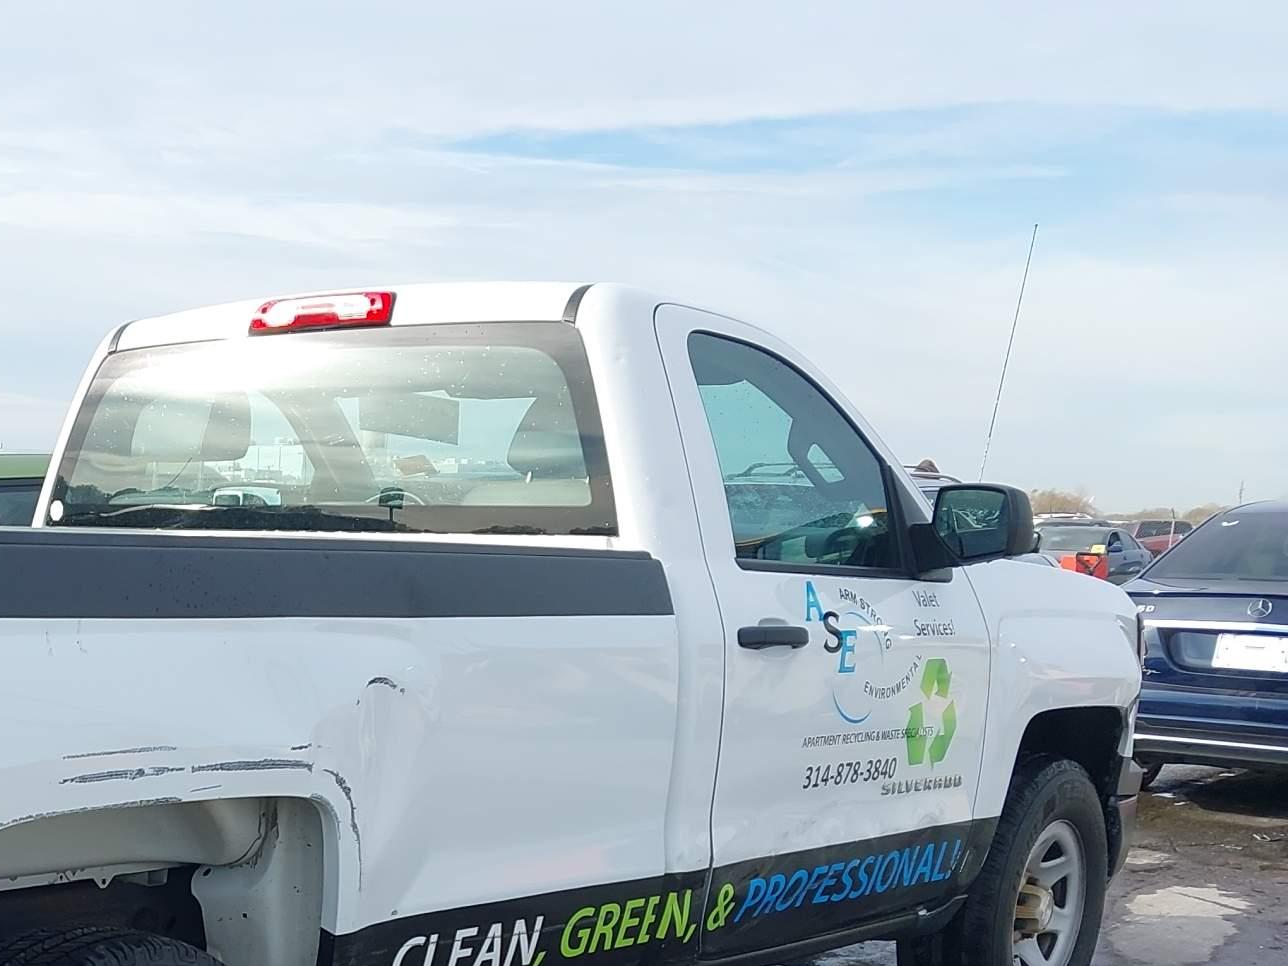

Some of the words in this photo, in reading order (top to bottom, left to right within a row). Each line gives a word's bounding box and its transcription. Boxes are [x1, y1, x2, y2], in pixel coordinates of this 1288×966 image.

[912, 590, 940, 608] Valet
[913, 618, 956, 636] Services!
[864, 655, 922, 699] ENVIRONMENTAL
[802, 734, 841, 748] APARTMENT
[842, 730, 876, 745] RECYCLING
[880, 729, 901, 741] WASTE
[901, 726, 934, 740] SPECIALISTS
[802, 757, 897, 790] 314-878-3840
[881, 774, 962, 795] SILVERADO
[560, 890, 697, 959] GREEN,
[707, 883, 737, 934] &
[735, 839, 962, 924] PROFESSIONAL!
